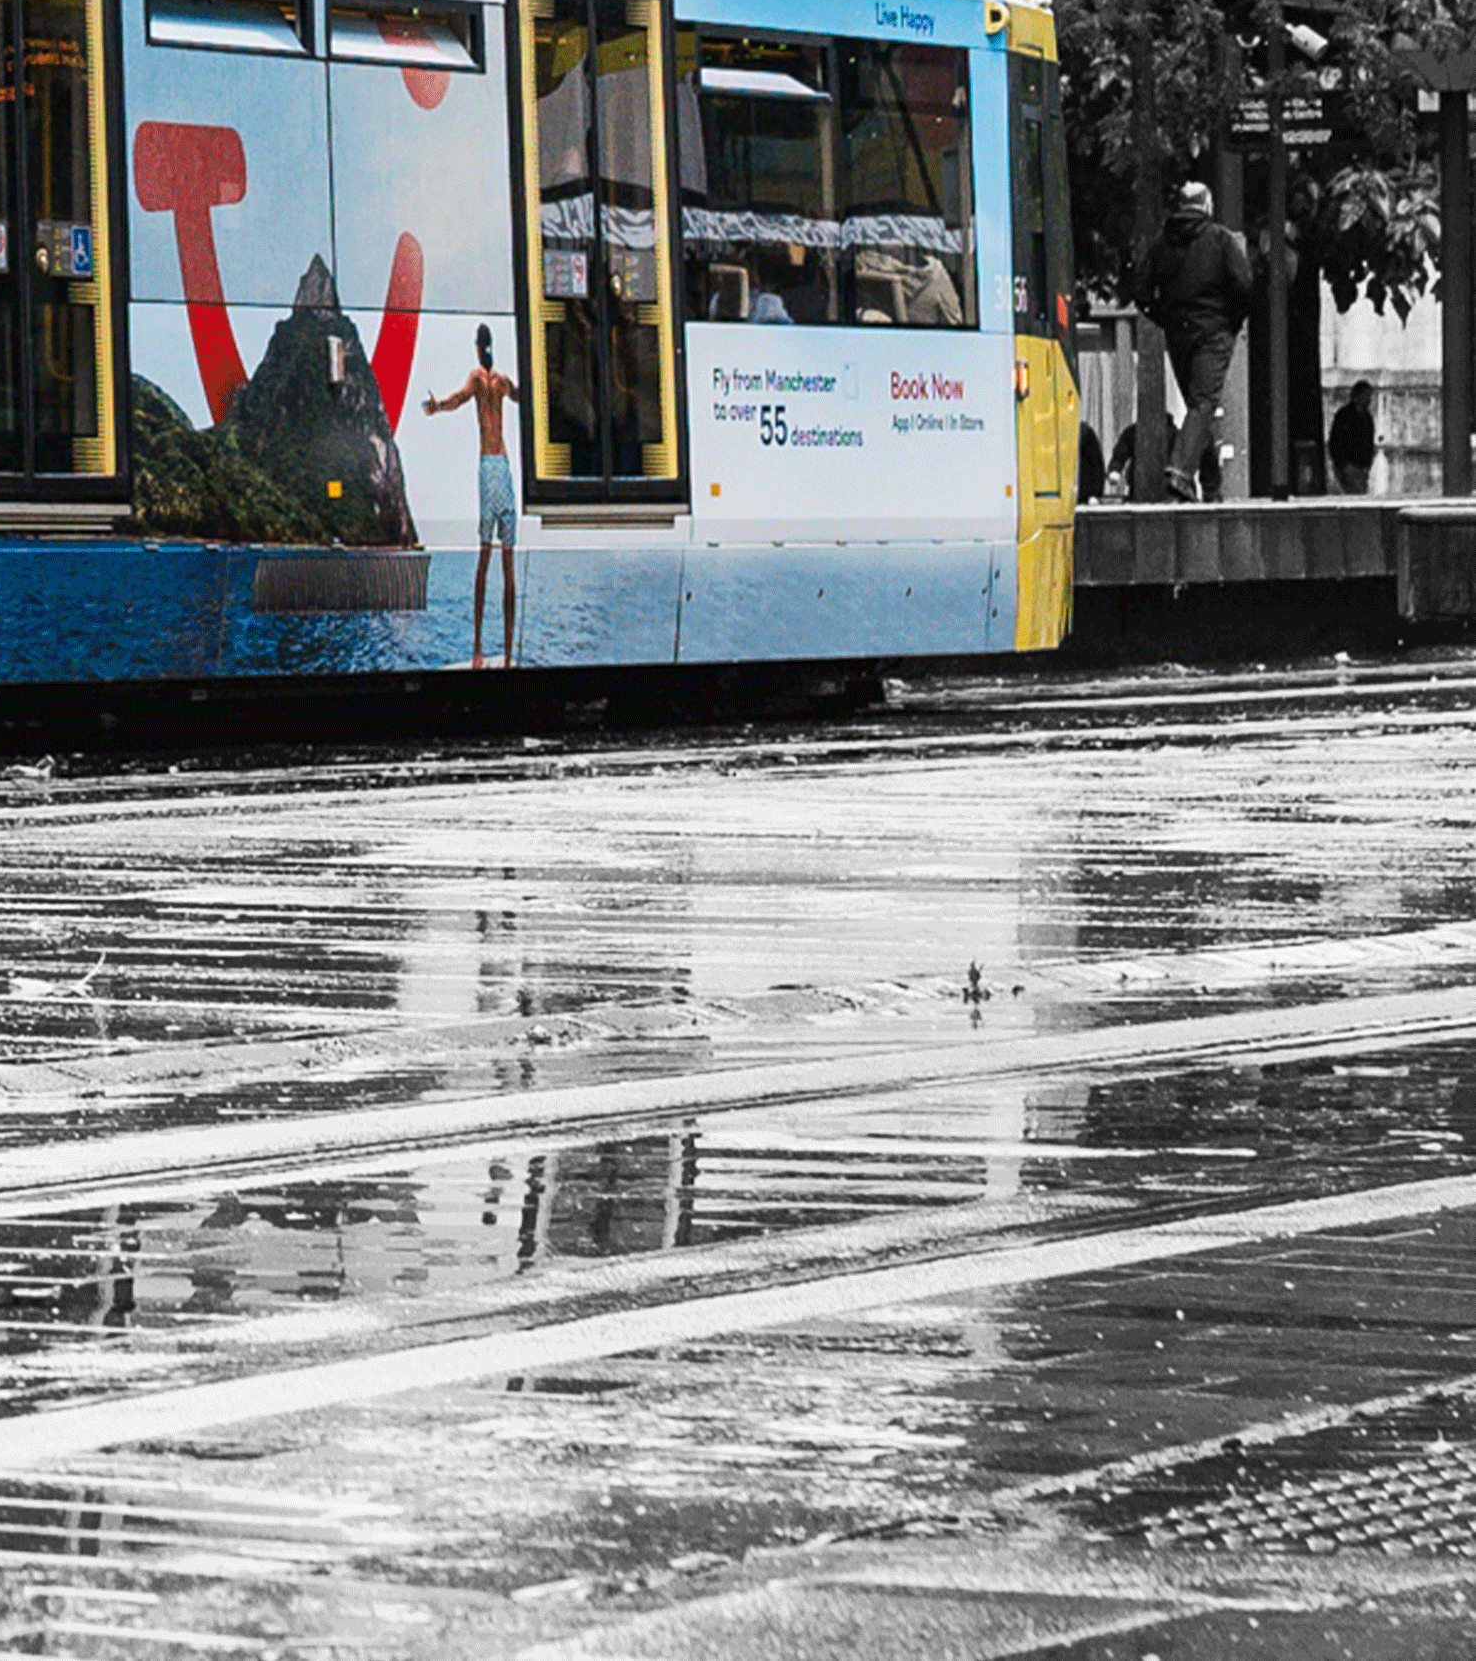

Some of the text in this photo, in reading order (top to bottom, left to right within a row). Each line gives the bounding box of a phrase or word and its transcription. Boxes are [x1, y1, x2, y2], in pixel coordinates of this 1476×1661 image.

[890, 370, 965, 400] Book Now
[759, 404, 789, 447] 55
